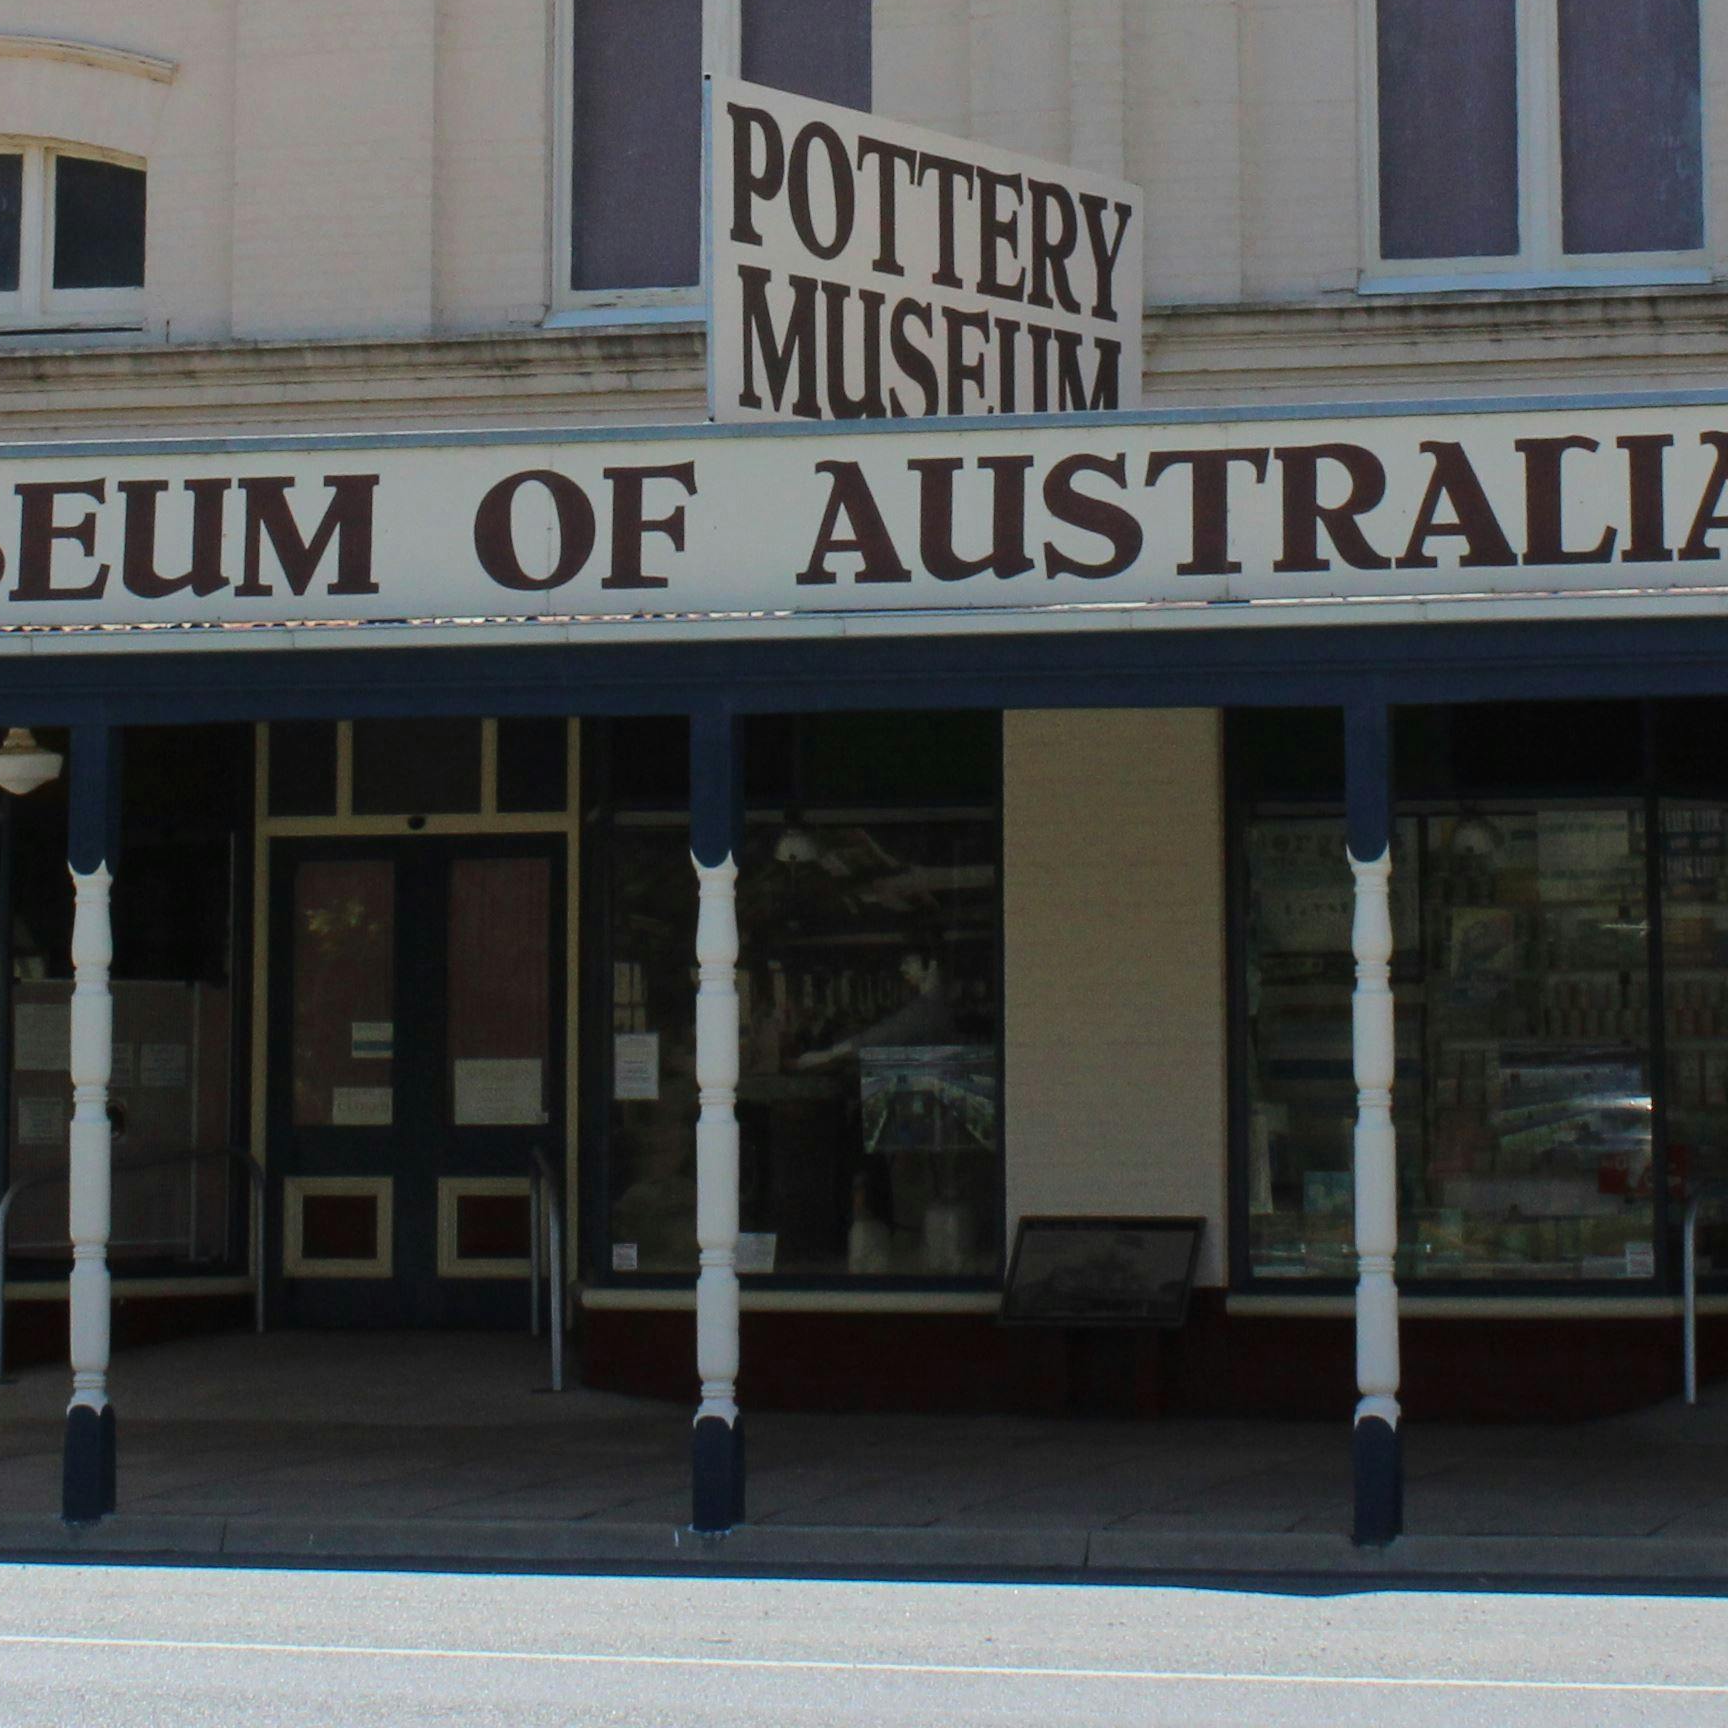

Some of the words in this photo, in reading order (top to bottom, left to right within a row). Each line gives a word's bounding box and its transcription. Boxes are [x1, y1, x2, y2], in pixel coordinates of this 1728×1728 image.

[726, 101, 1132, 323] POTTERY
[737, 263, 1122, 422] MUSEUM
[473, 460, 698, 592] OF
